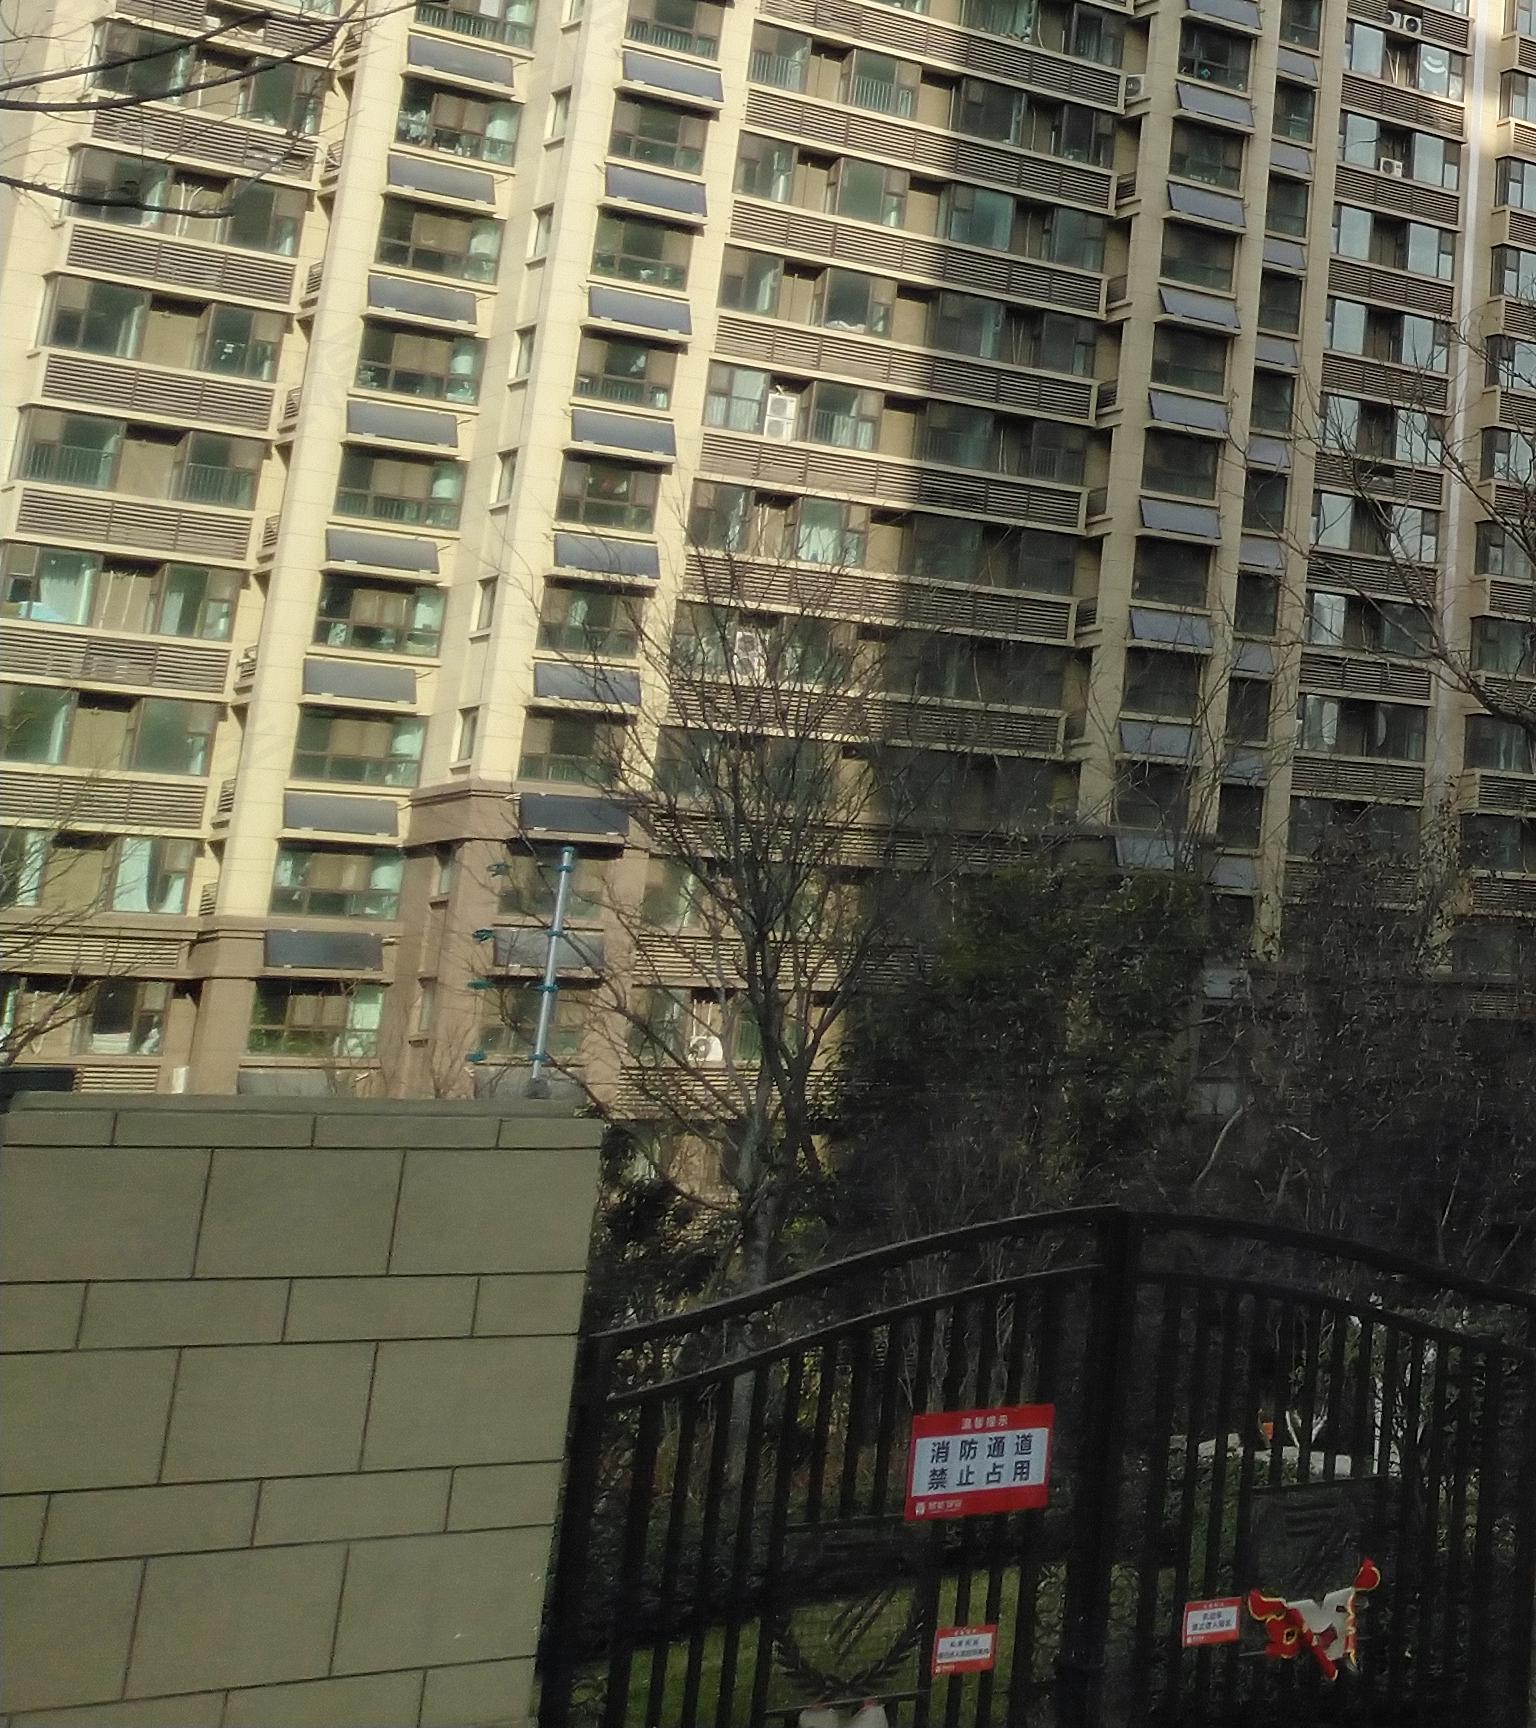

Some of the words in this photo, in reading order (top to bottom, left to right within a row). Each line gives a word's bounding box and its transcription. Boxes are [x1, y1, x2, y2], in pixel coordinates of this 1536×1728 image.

[931, 1432, 1034, 1463] 消防通道
[928, 1460, 1031, 1491] 禁止占用
